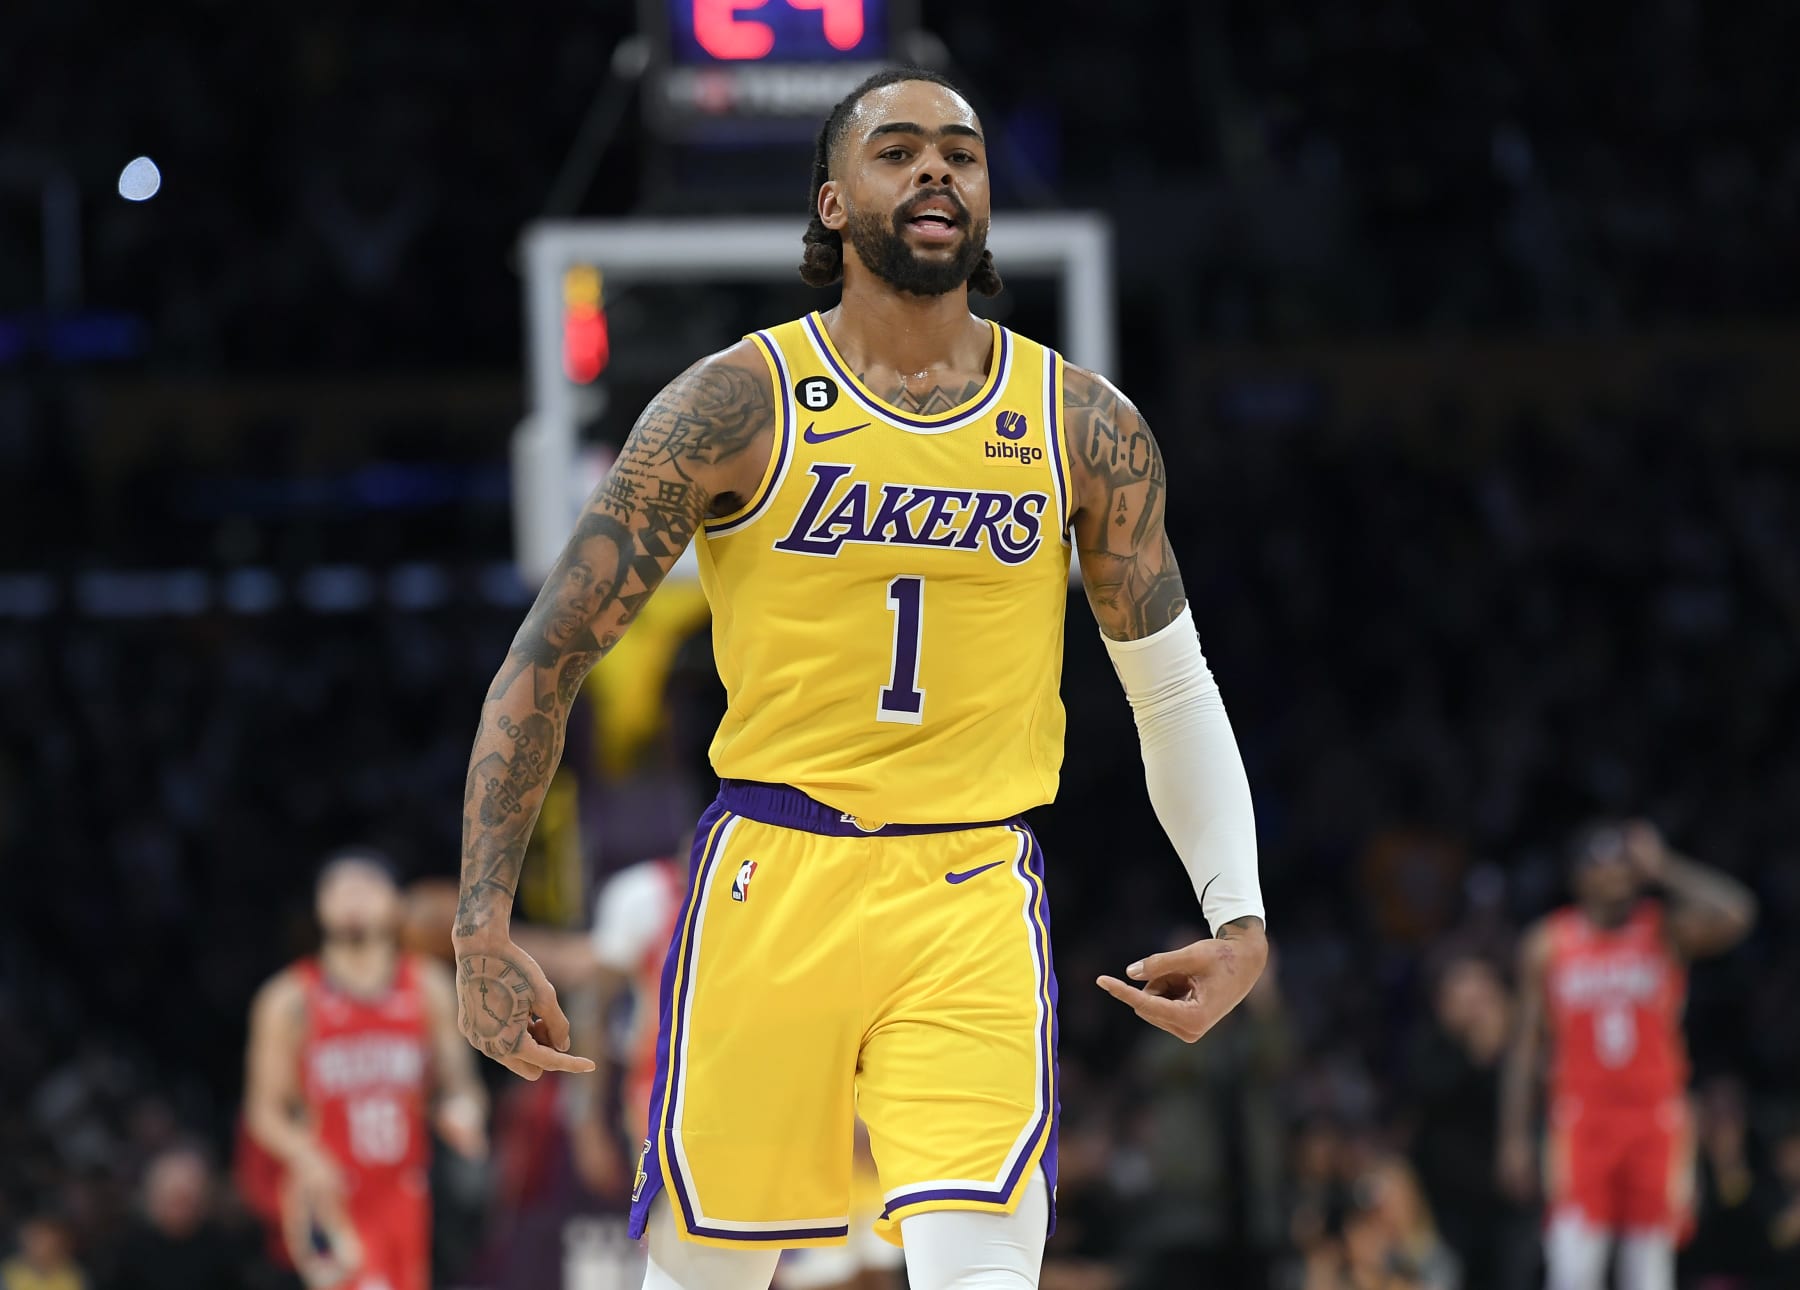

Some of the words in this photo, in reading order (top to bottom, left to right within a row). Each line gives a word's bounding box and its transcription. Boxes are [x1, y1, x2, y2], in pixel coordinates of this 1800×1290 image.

[805, 381, 828, 407] 6
[984, 441, 1043, 465] bibigo
[772, 463, 1049, 566] LAKERS
[1116, 491, 1128, 512] A
[876, 574, 926, 726] 1
[497, 714, 530, 748] GOD
[485, 777, 522, 814] STEP
